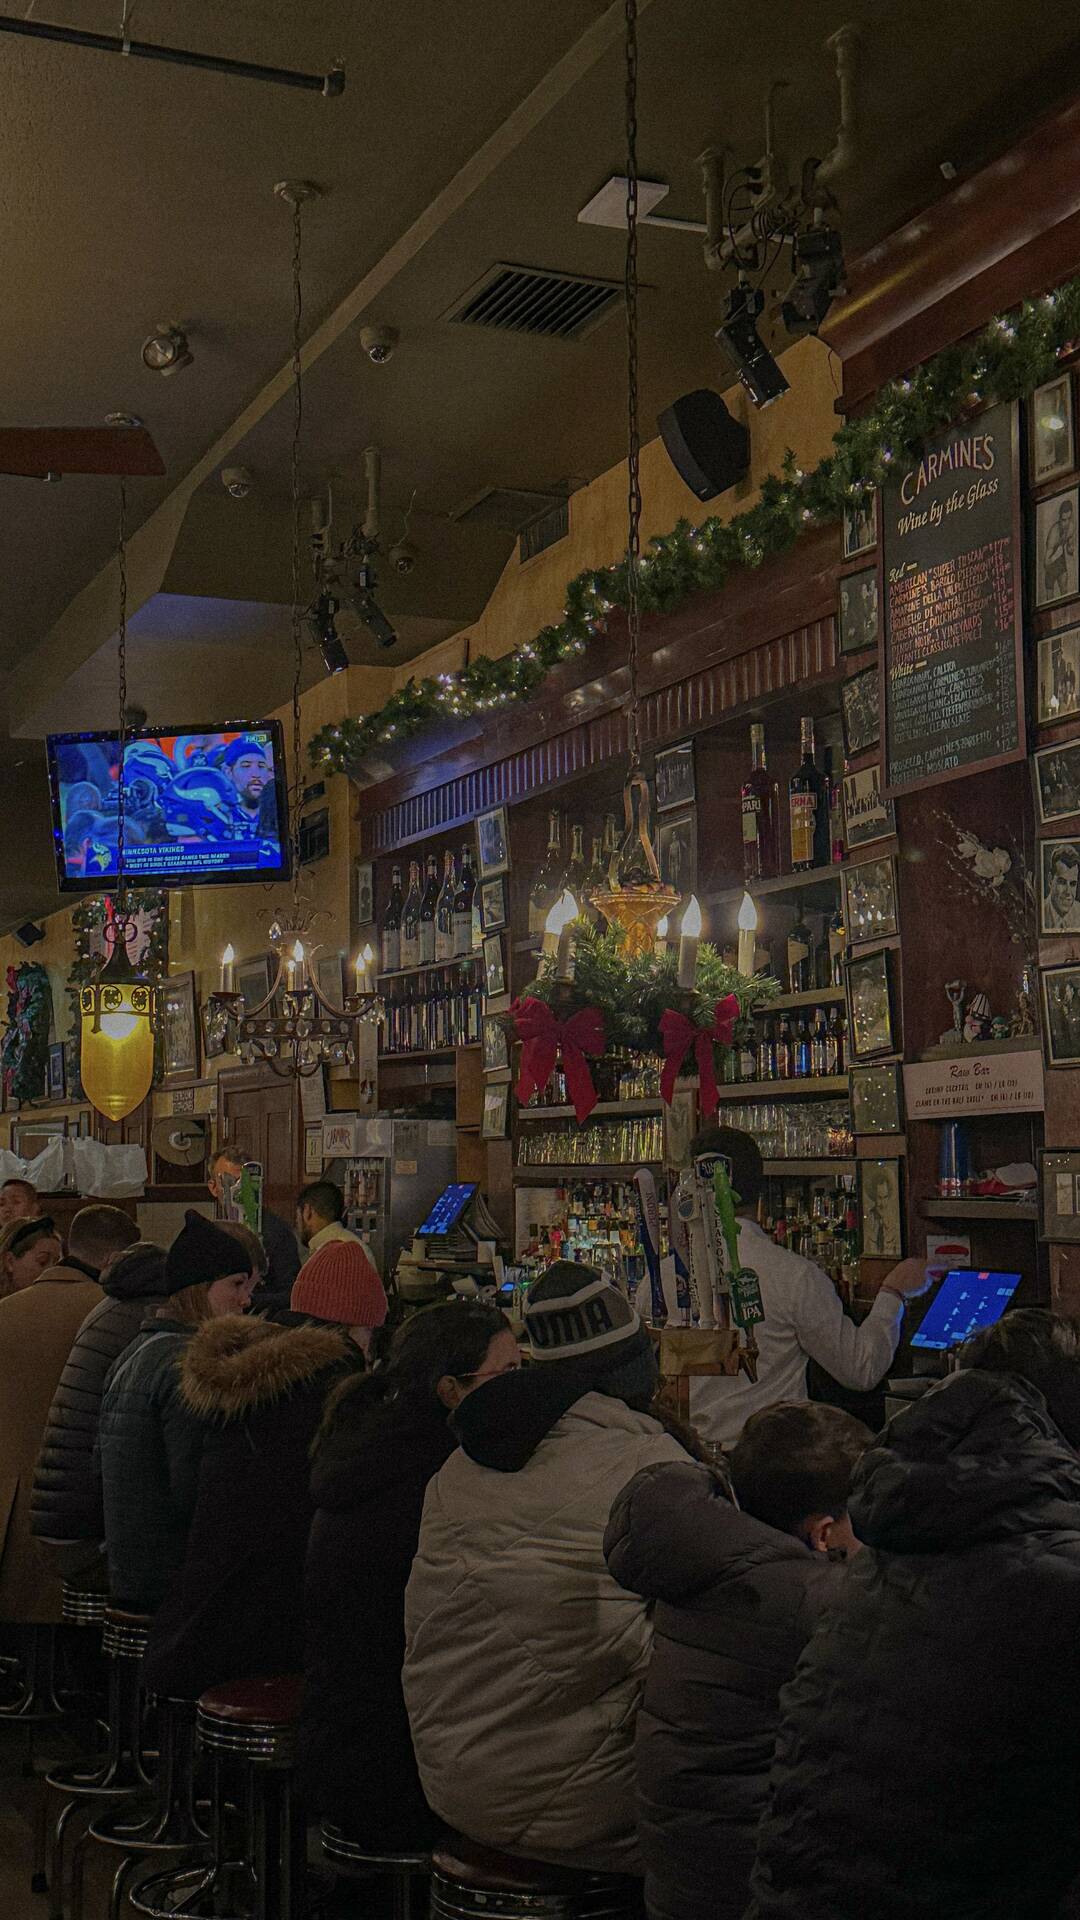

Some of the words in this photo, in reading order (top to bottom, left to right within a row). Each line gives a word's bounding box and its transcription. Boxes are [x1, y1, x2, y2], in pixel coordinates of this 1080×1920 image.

[901, 433, 995, 505] CARMINE'S
[898, 511, 928, 537] Wine
[930, 500, 944, 527] by
[946, 490, 965, 515] the
[967, 478, 999, 511] Glass
[888, 571, 927, 595] AMERICAN
[922, 590, 941, 604] DELLA
[742, 799, 761, 812] PARI
[950, 1064, 971, 1079] Raw
[973, 1062, 992, 1076] Bar
[713, 1207, 726, 1286] SEASONAL
[525, 1297, 613, 1346] UMA
[743, 1304, 762, 1321] IPA
